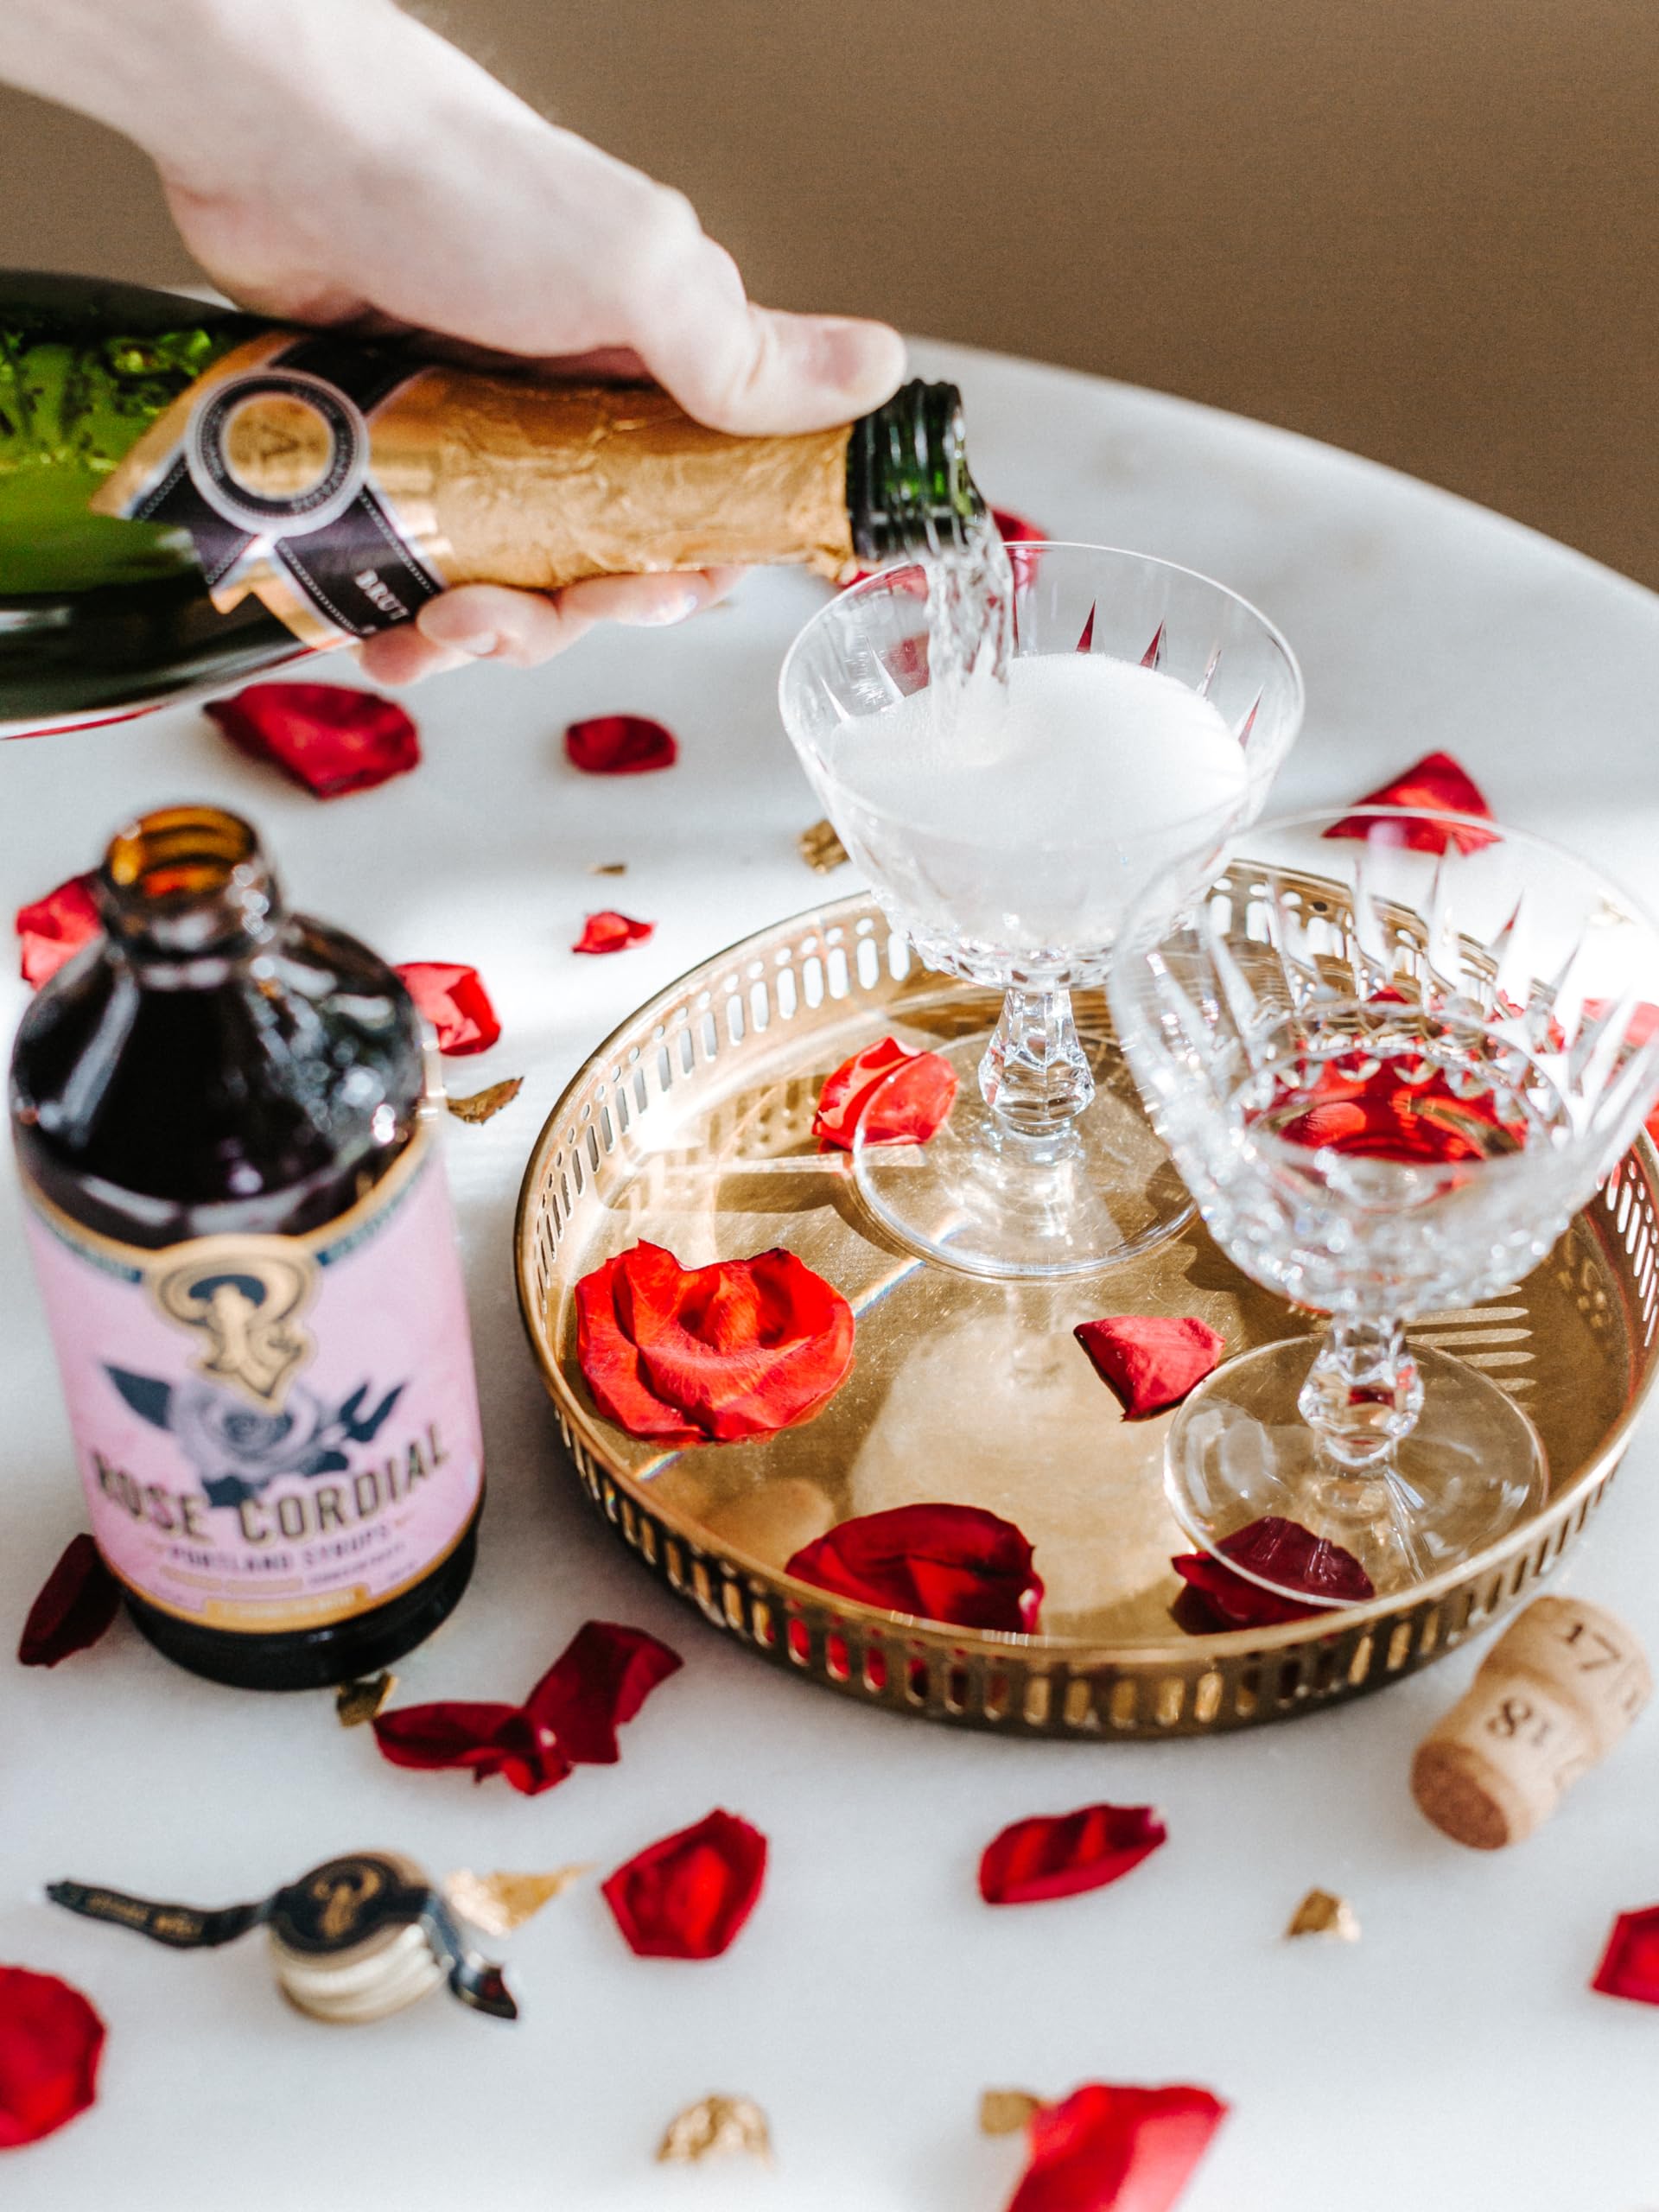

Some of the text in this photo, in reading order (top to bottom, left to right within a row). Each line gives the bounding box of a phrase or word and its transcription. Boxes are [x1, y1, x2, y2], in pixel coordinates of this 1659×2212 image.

[354, 569, 410, 620] BRUT
[92, 1424, 450, 1545] ROSE CORDIAL
[171, 1546, 293, 1572] PORTLAND
[303, 1524, 389, 1566] SYRUPS
